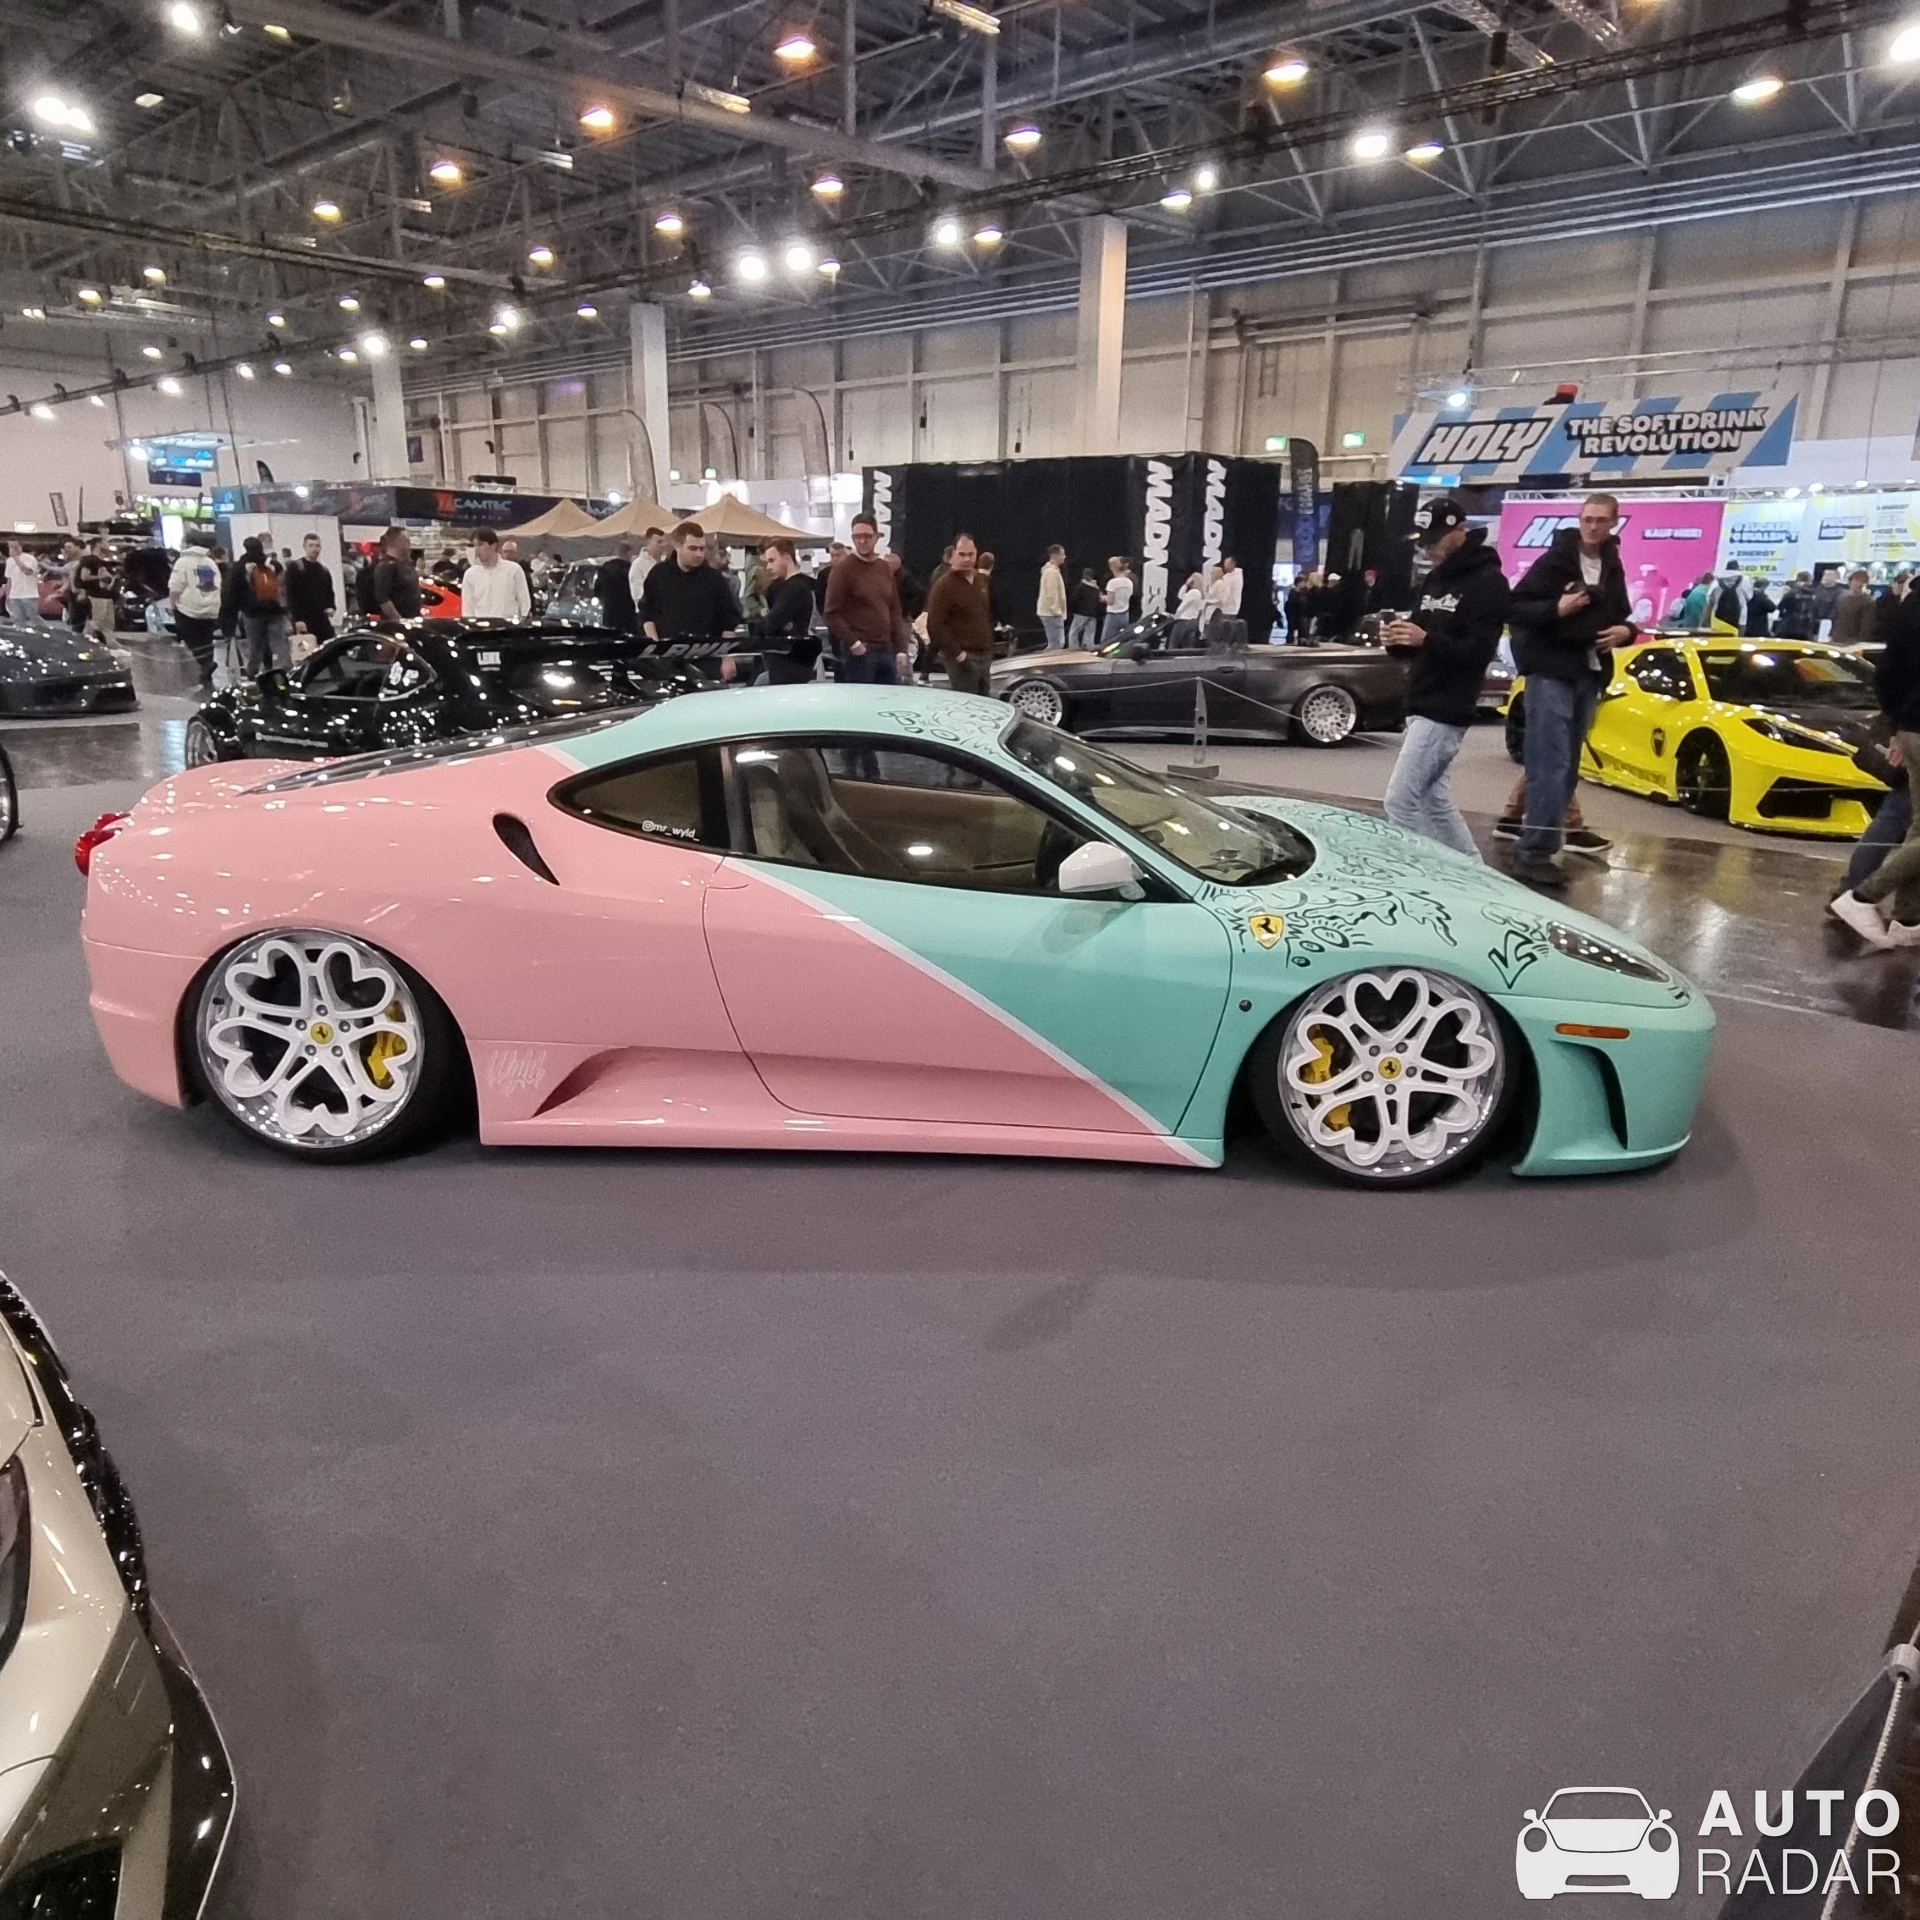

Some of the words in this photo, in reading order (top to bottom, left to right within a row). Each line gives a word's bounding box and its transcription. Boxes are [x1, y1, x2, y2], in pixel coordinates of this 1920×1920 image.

[1569, 418, 1612, 436] THE
[1616, 407, 1767, 433] SOFTDRINK
[1415, 420, 1549, 463] HOLY
[1584, 430, 1740, 454] REVOLUTION
[642, 820, 700, 842] @mr_wyld_
